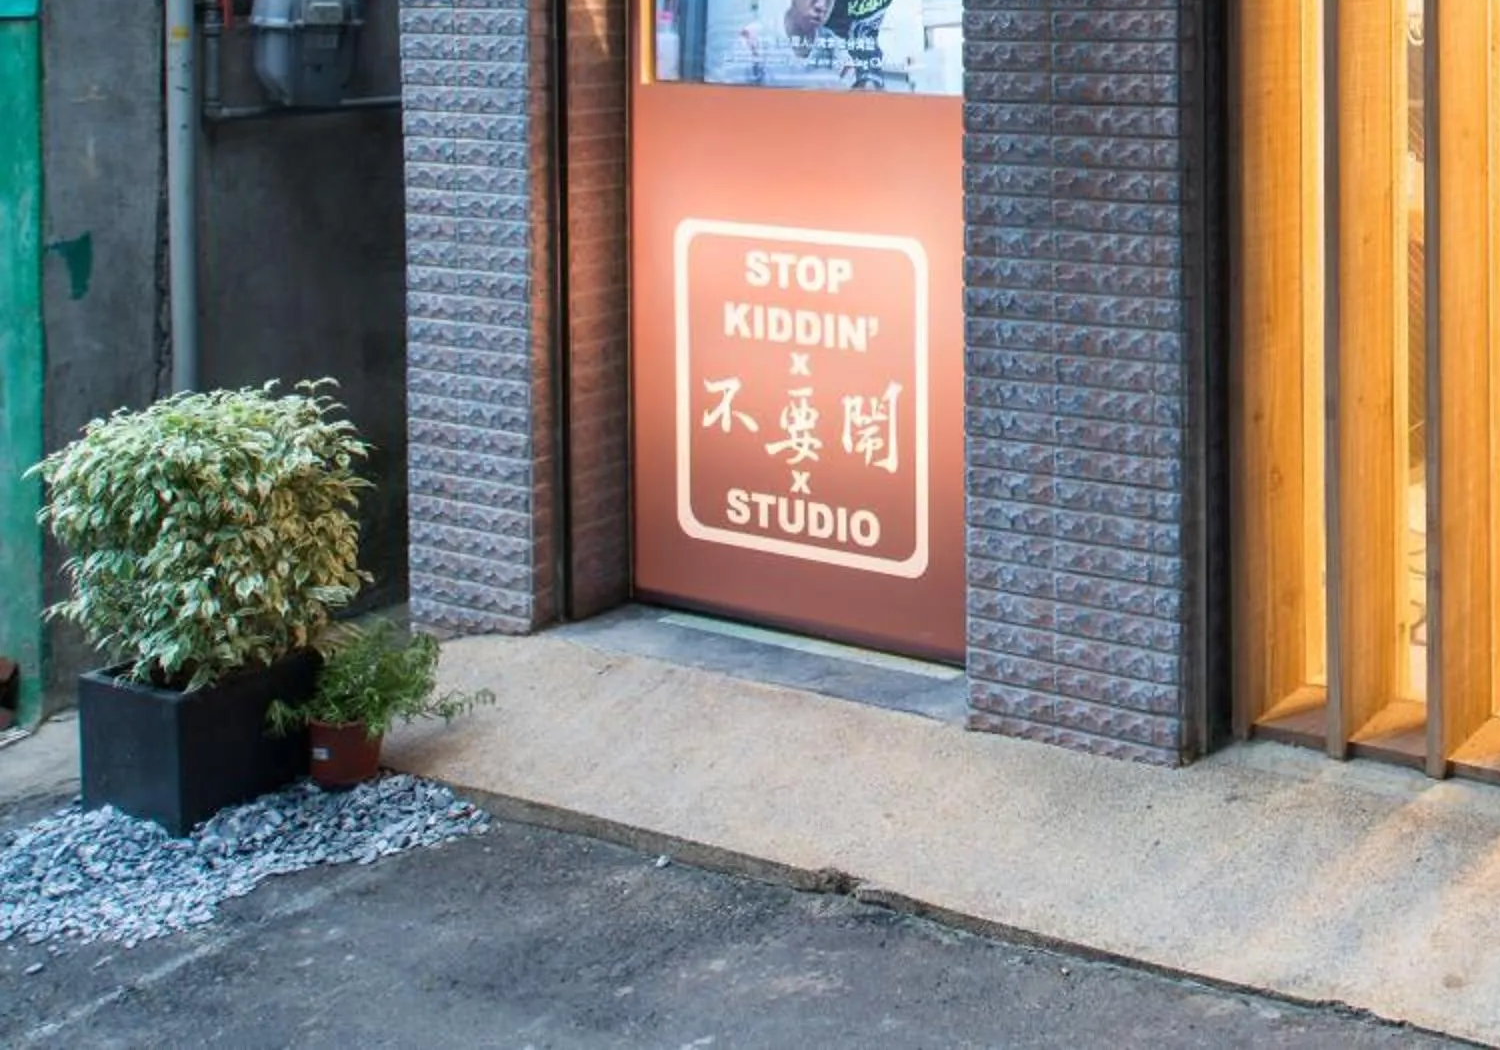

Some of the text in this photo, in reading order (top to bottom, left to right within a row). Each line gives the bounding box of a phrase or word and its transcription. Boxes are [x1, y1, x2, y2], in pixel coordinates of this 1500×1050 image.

[745, 249, 852, 294] STOP
[724, 301, 879, 352] KIDDIN'
[726, 488, 880, 547] STUDIO
